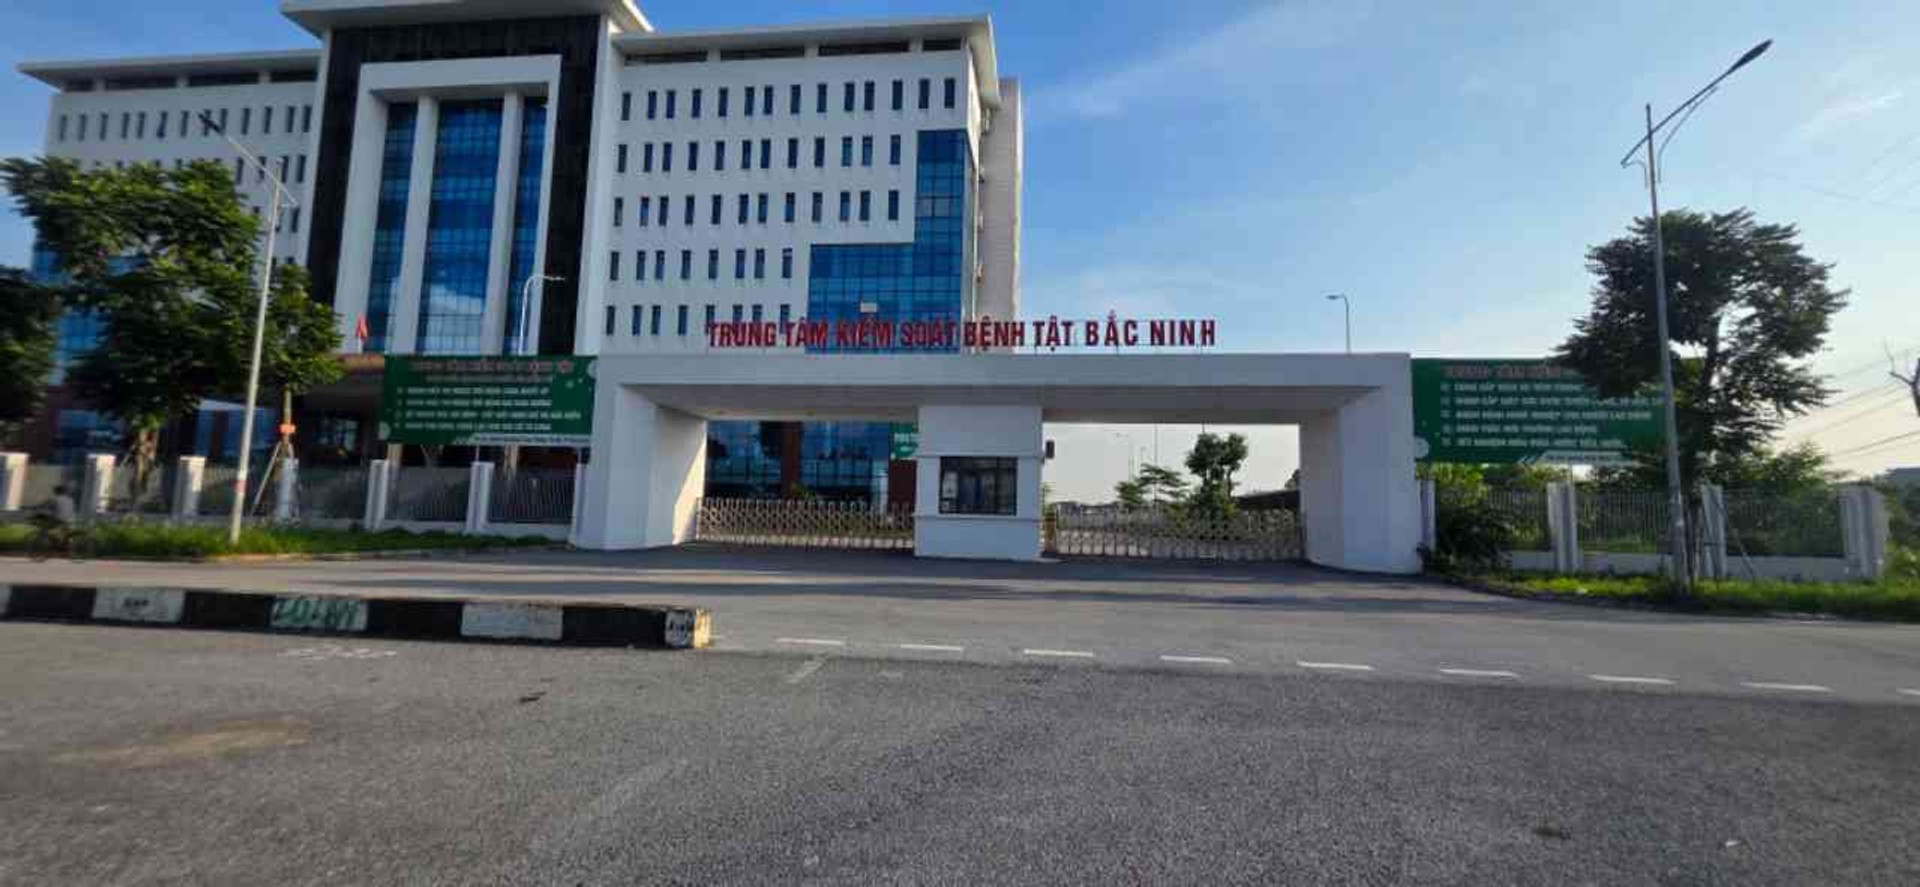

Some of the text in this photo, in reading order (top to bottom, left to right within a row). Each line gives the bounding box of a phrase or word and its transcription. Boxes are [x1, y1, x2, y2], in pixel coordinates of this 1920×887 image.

[708, 310, 1215, 351] TRUNG TÂM KIỂM SOÁT BỆNH TẬT BẮC NINH
